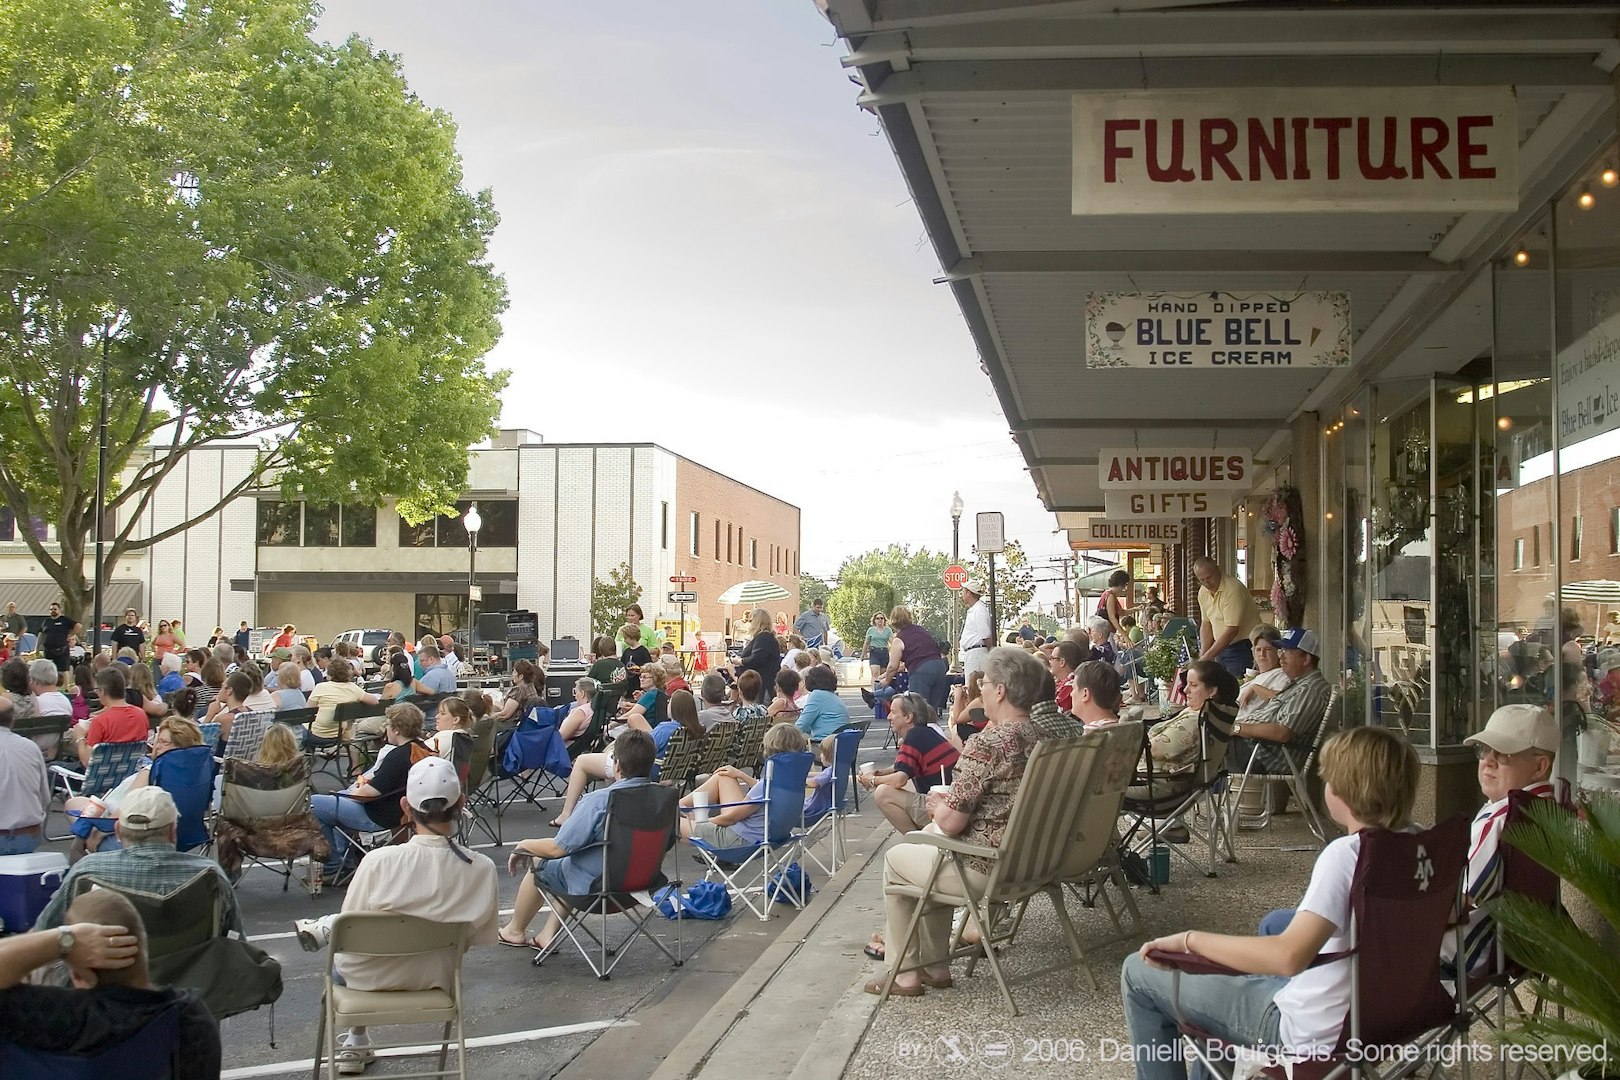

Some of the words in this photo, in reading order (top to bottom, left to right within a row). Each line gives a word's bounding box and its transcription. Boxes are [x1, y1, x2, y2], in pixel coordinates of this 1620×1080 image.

[1104, 115, 1497, 183] FURNITURE
[1148, 303, 1198, 313] HAND
[1213, 303, 1291, 313] DIPPED
[1137, 318, 1213, 346] BLUE
[1225, 318, 1302, 346] BELL
[1149, 351, 1193, 365] ICE
[1211, 351, 1292, 365] CREAM
[1561, 408, 1577, 438] Blue
[1578, 396, 1592, 429] Bell
[1605, 384, 1619, 416] Ice
[1107, 455, 1245, 482] ANTIQUES
[1130, 492, 1208, 514] GIFTS
[1092, 524, 1178, 539] COLLECTIBLES
[945, 572, 966, 582] STOP
